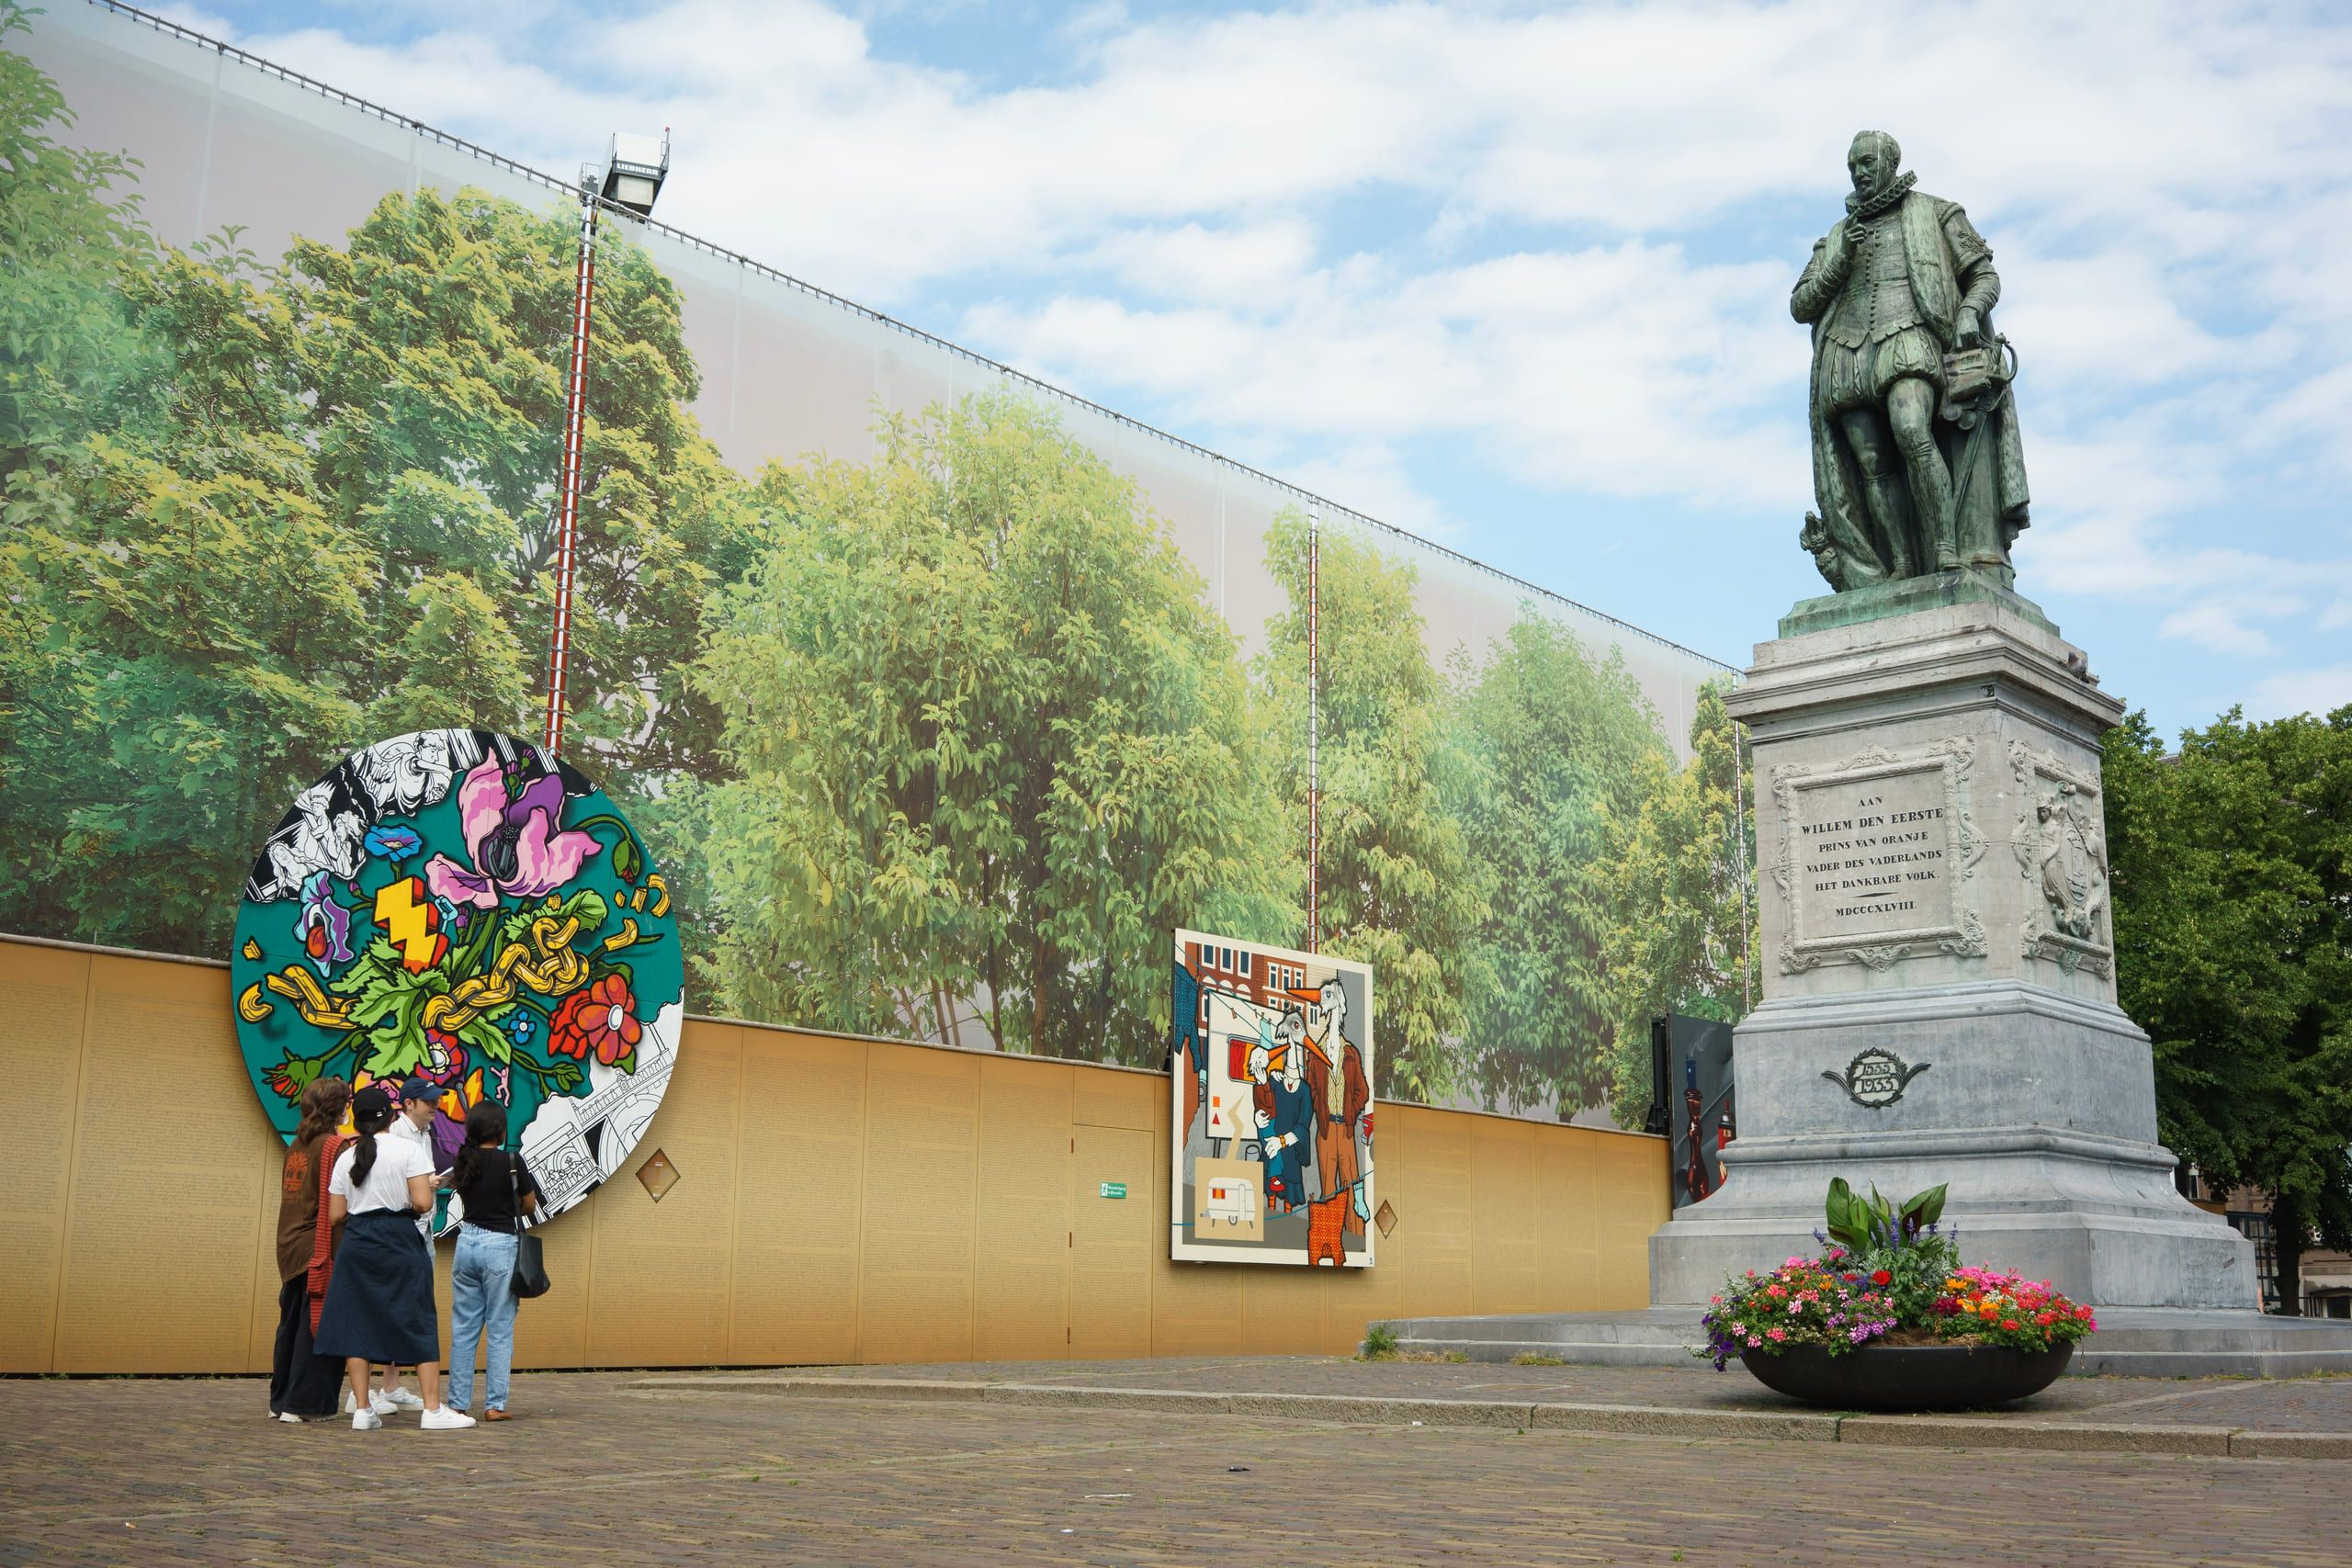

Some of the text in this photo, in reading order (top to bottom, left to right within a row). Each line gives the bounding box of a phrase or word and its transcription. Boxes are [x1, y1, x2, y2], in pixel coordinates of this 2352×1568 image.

[616, 163, 659, 175] LIEBHERR
[1858, 795, 1883, 807] AAN
[1802, 807, 1943, 835] WILLEM DEN EERSTE
[1819, 831, 1928, 852] PRINS VAN ORANJE
[1806, 850, 1942, 873] VADER DES VADERLANDS
[1815, 870, 1940, 892] HET DANKBARE VOLK.
[1861, 1078, 1894, 1093] 1933
